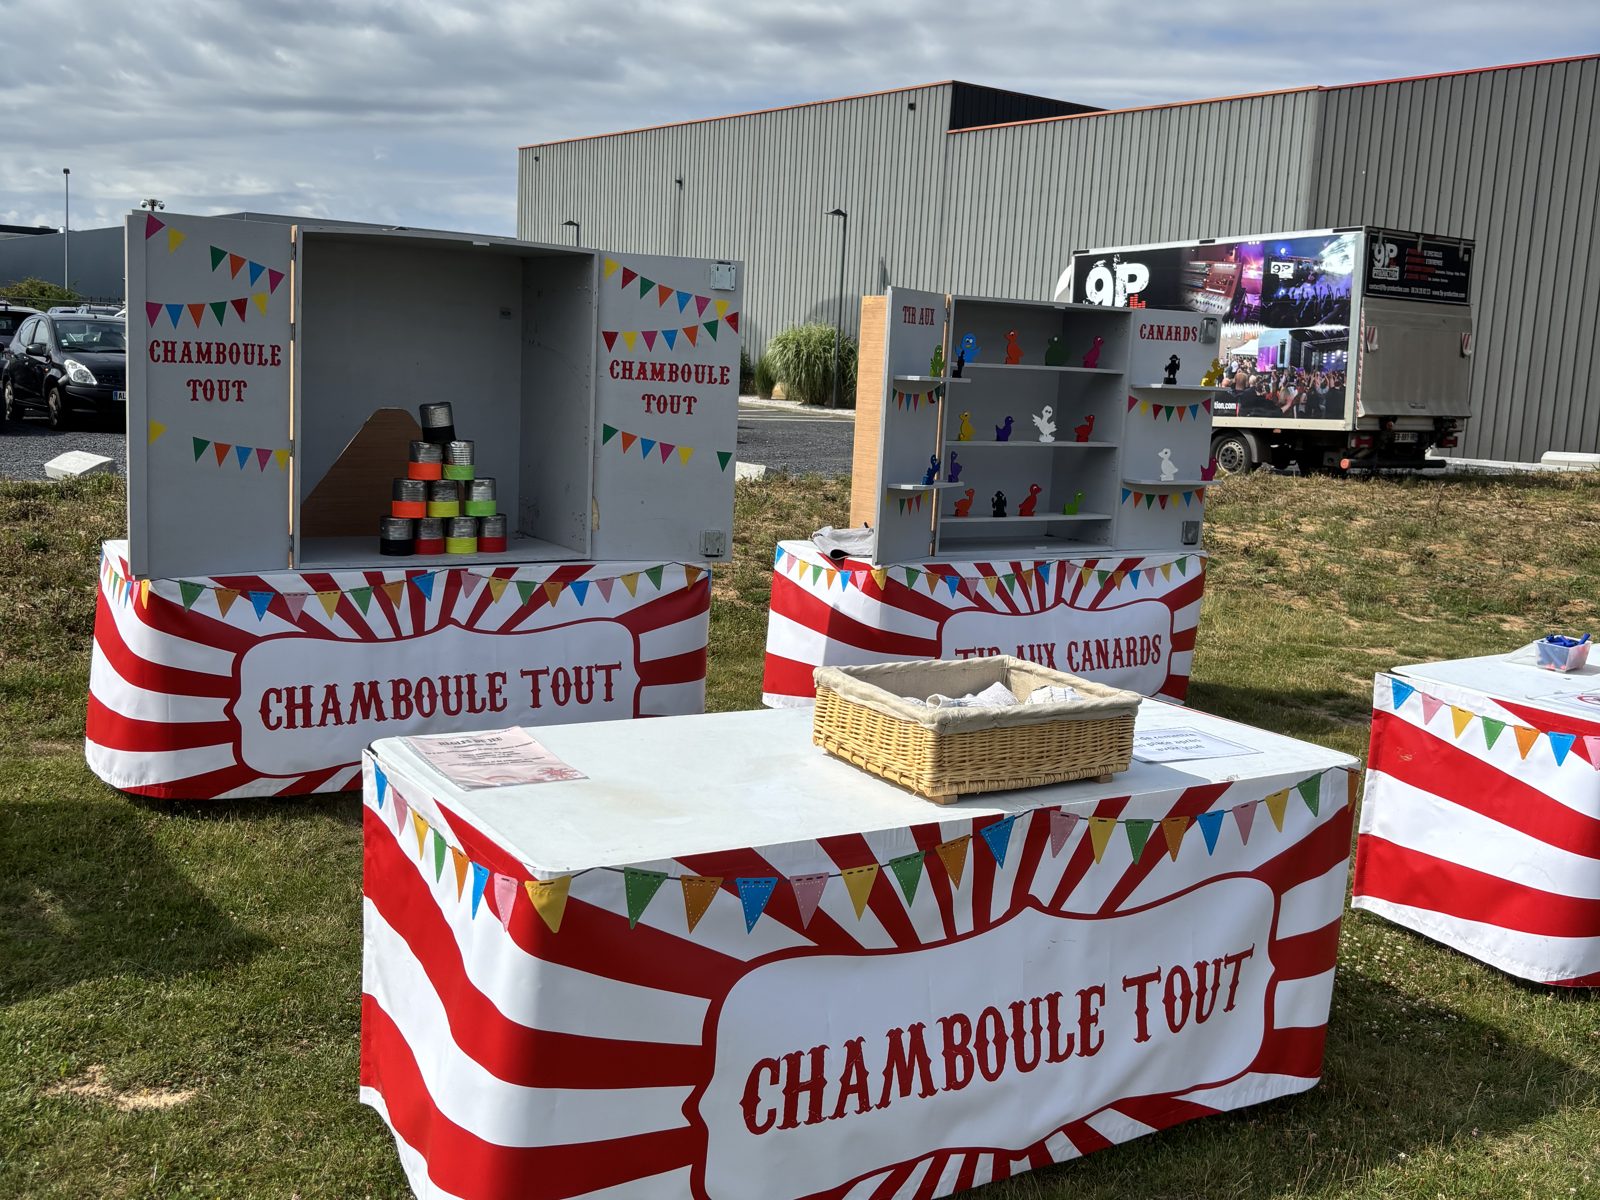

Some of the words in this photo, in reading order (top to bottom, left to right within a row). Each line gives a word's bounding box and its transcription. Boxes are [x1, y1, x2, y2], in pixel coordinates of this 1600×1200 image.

[1372, 240, 1398, 268] 9P
[1083, 254, 1150, 307] 9P
[903, 305, 917, 325] TIR
[918, 307, 936, 326] AUX
[1139, 323, 1198, 342] CANARDS
[149, 340, 282, 366] CHAMBOULE
[609, 359, 730, 385] CHAMBOULE
[186, 379, 248, 402] TOUT
[641, 393, 698, 415] TOUT
[1067, 634, 1162, 673] CANARDS
[259, 671, 507, 731] CHAMBOULE
[520, 661, 622, 709] TOUT
[739, 983, 1105, 1136] CHAMBOULE
[1122, 943, 1255, 1044] TOUT
